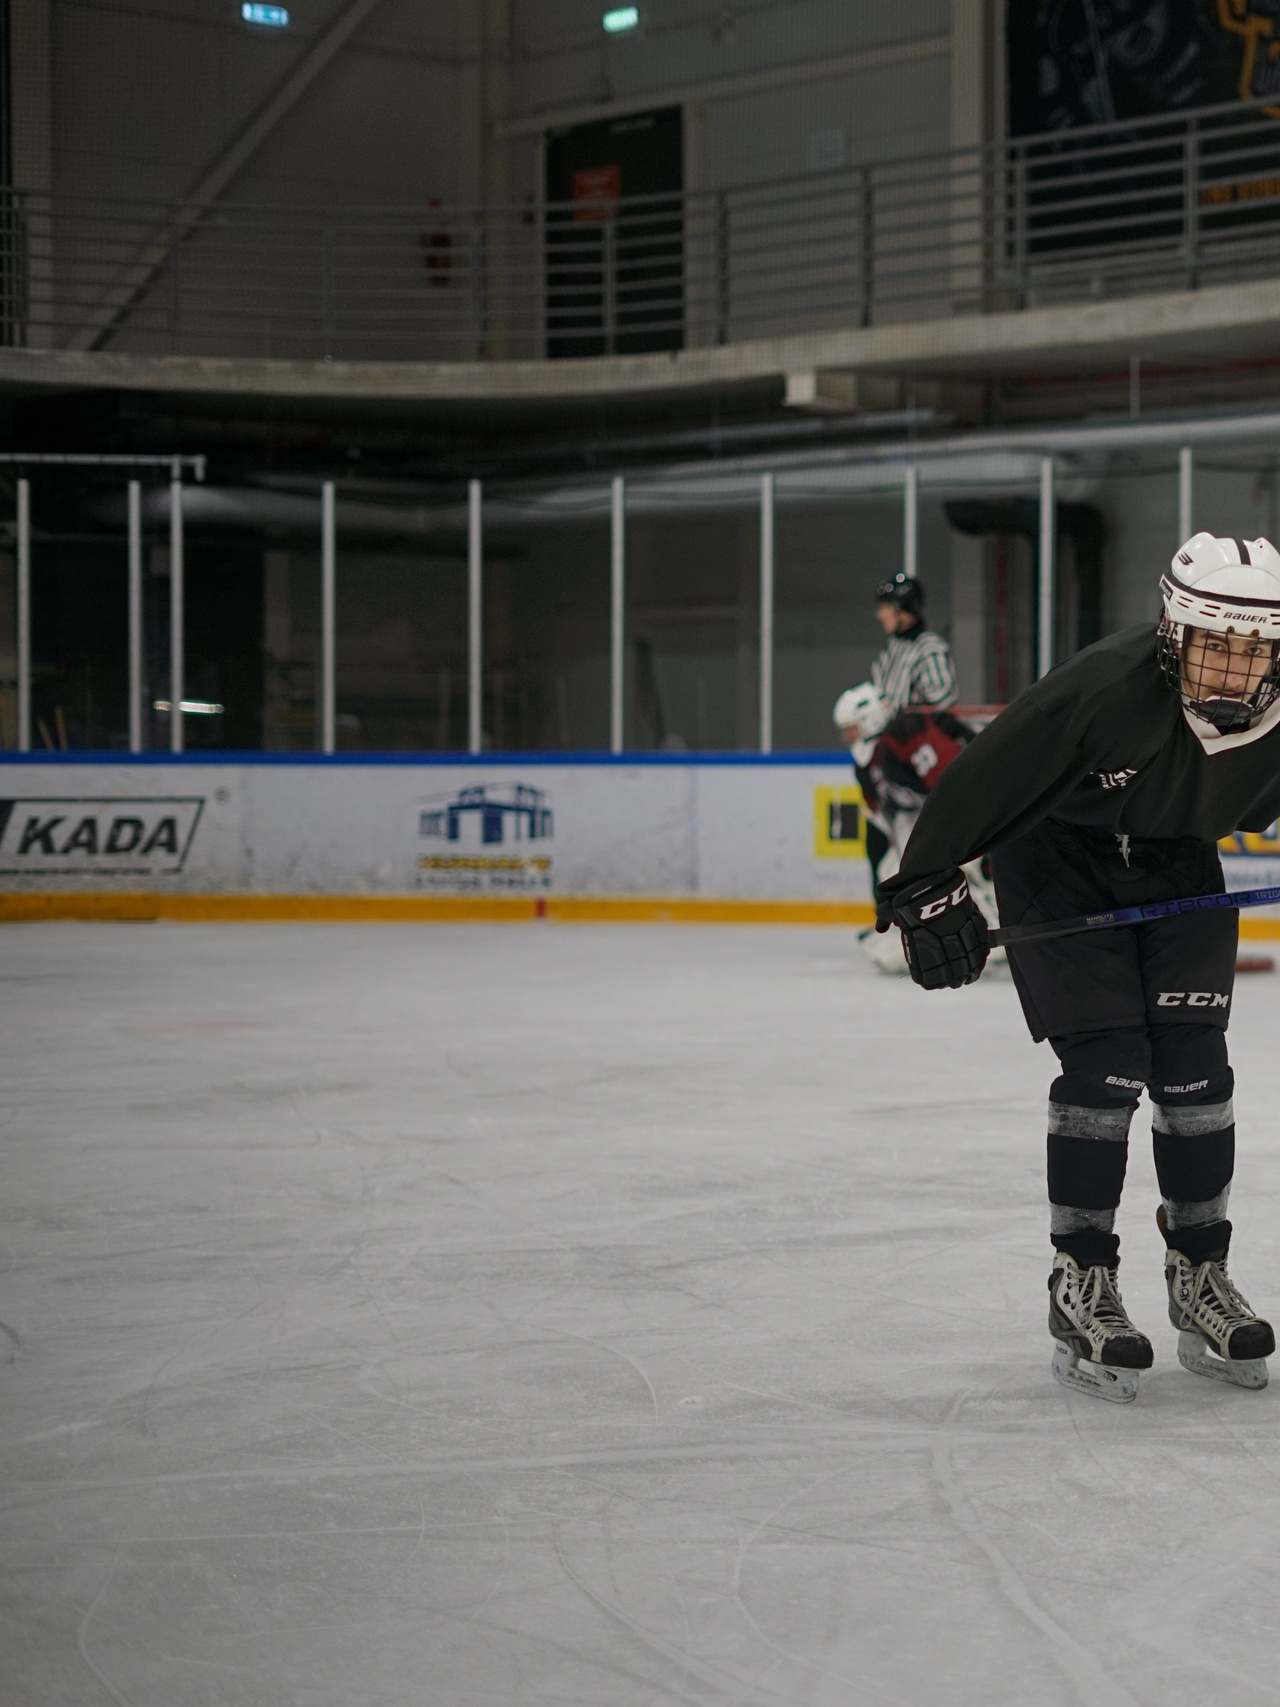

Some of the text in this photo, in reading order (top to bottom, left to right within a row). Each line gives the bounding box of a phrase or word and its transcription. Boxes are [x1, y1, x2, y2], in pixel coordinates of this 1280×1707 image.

[1223, 611, 1268, 624] BAUER
[16, 815, 179, 855] KADA
[919, 878, 969, 921] CC
[1156, 991, 1230, 1008] CCM
[1163, 1078, 1209, 1094] BAUER
